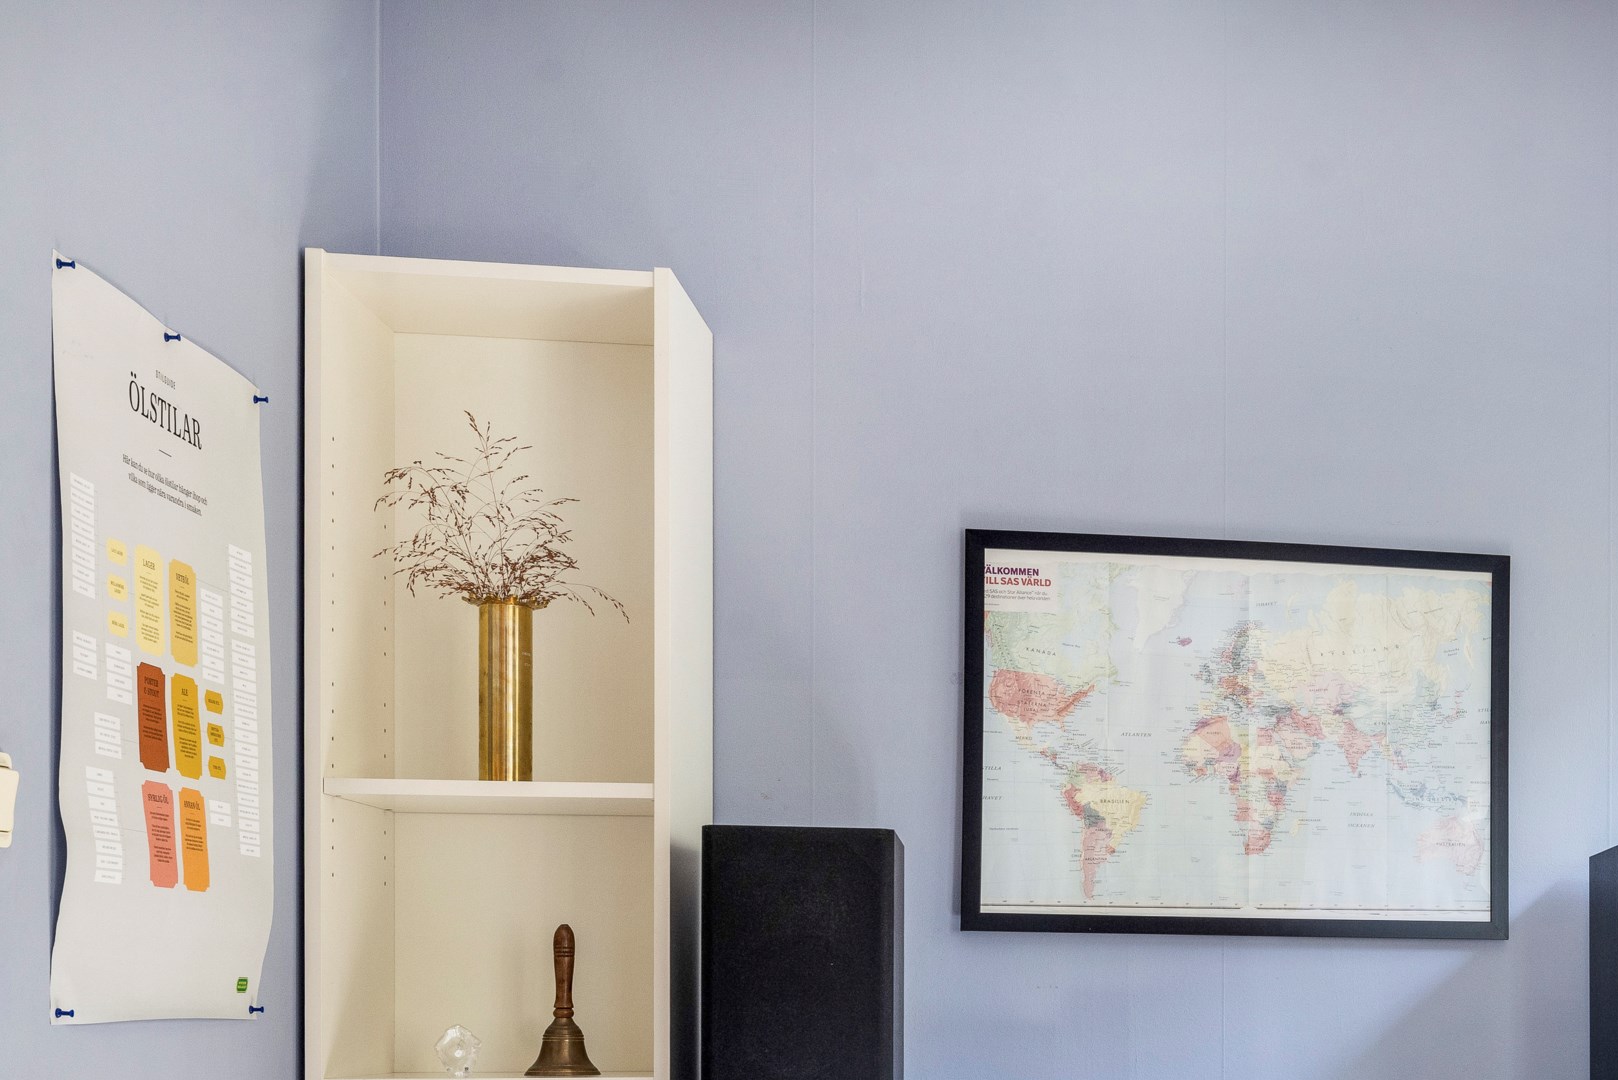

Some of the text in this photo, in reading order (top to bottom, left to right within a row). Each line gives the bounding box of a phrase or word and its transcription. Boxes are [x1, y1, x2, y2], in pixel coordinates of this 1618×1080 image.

[129, 370, 202, 451] ÖLSTILAR
[142, 558, 156, 571] LAGER
[984, 564, 1039, 577] ÄLKOMMEN
[984, 575, 1052, 587] ILL SAS VÄRLD
[1026, 647, 1057, 656] KANADA
